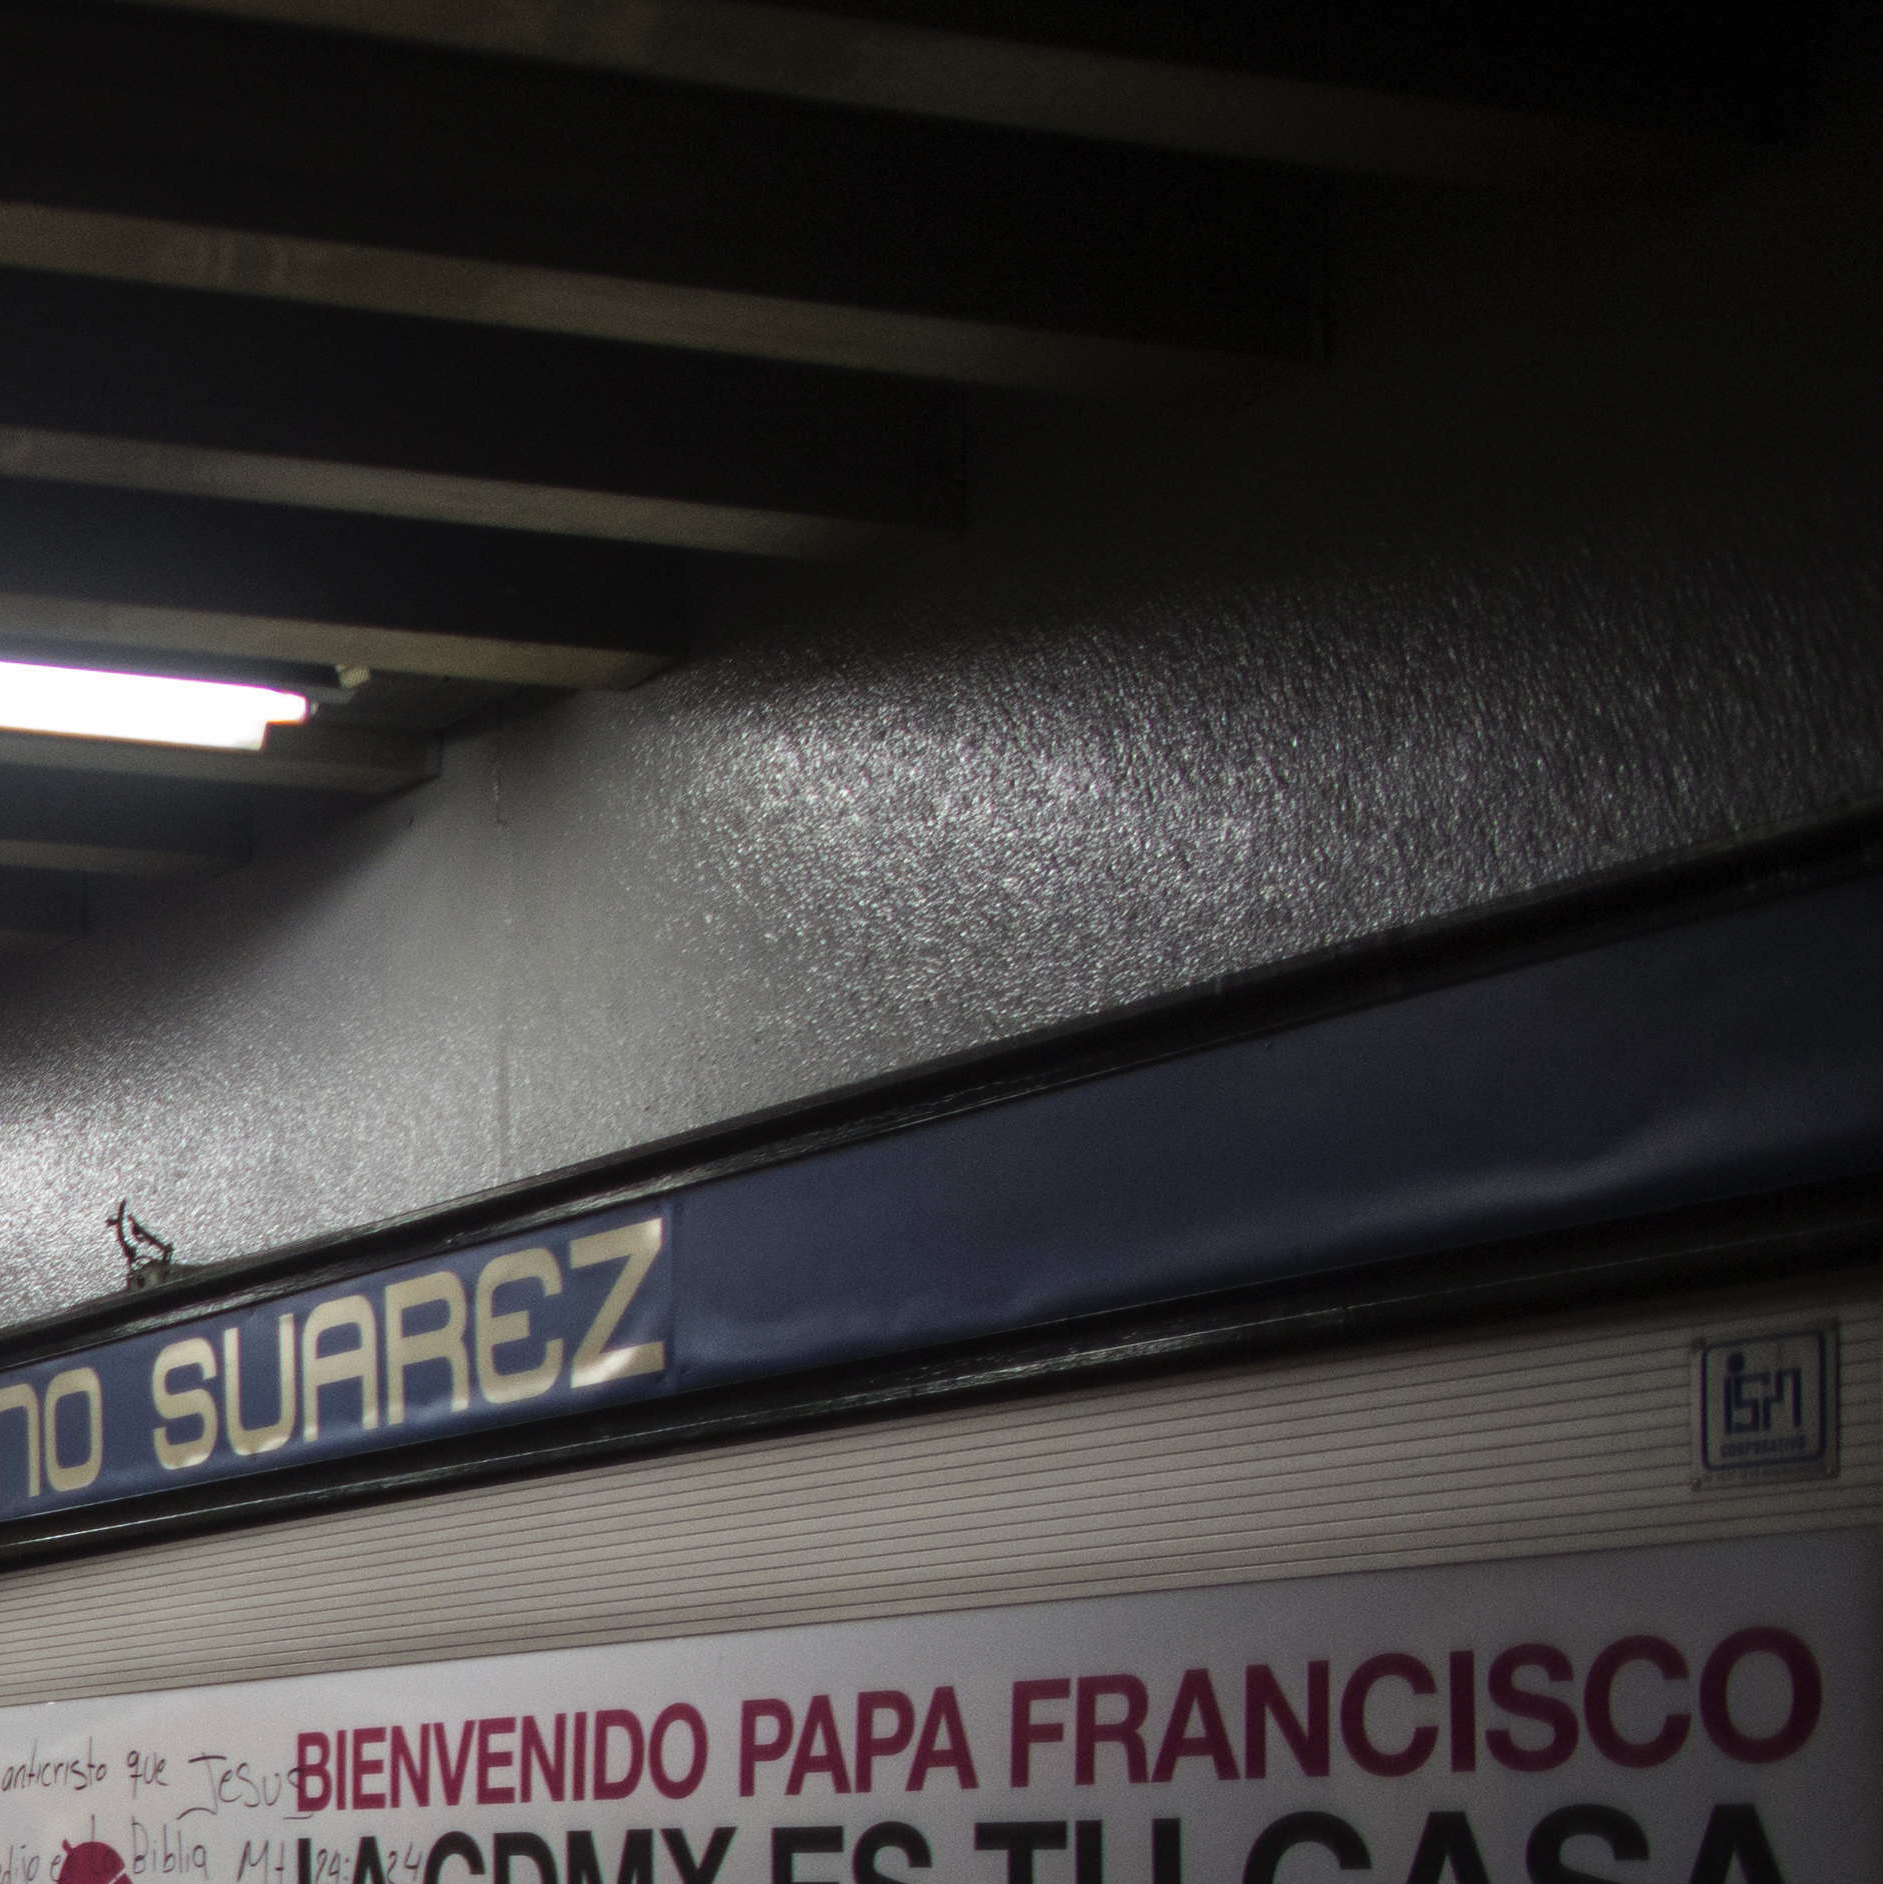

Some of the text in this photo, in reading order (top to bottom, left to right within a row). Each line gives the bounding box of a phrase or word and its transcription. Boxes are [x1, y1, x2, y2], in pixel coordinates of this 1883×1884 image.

[152, 1217, 665, 1470] SUAREZ
[2, 1737, 107, 1792] anticristo
[127, 1750, 168, 1798] que
[297, 1626, 1822, 1812] BIENVENIDO PAPA FRANCISCO
[131, 1815, 210, 1880] Biblia
